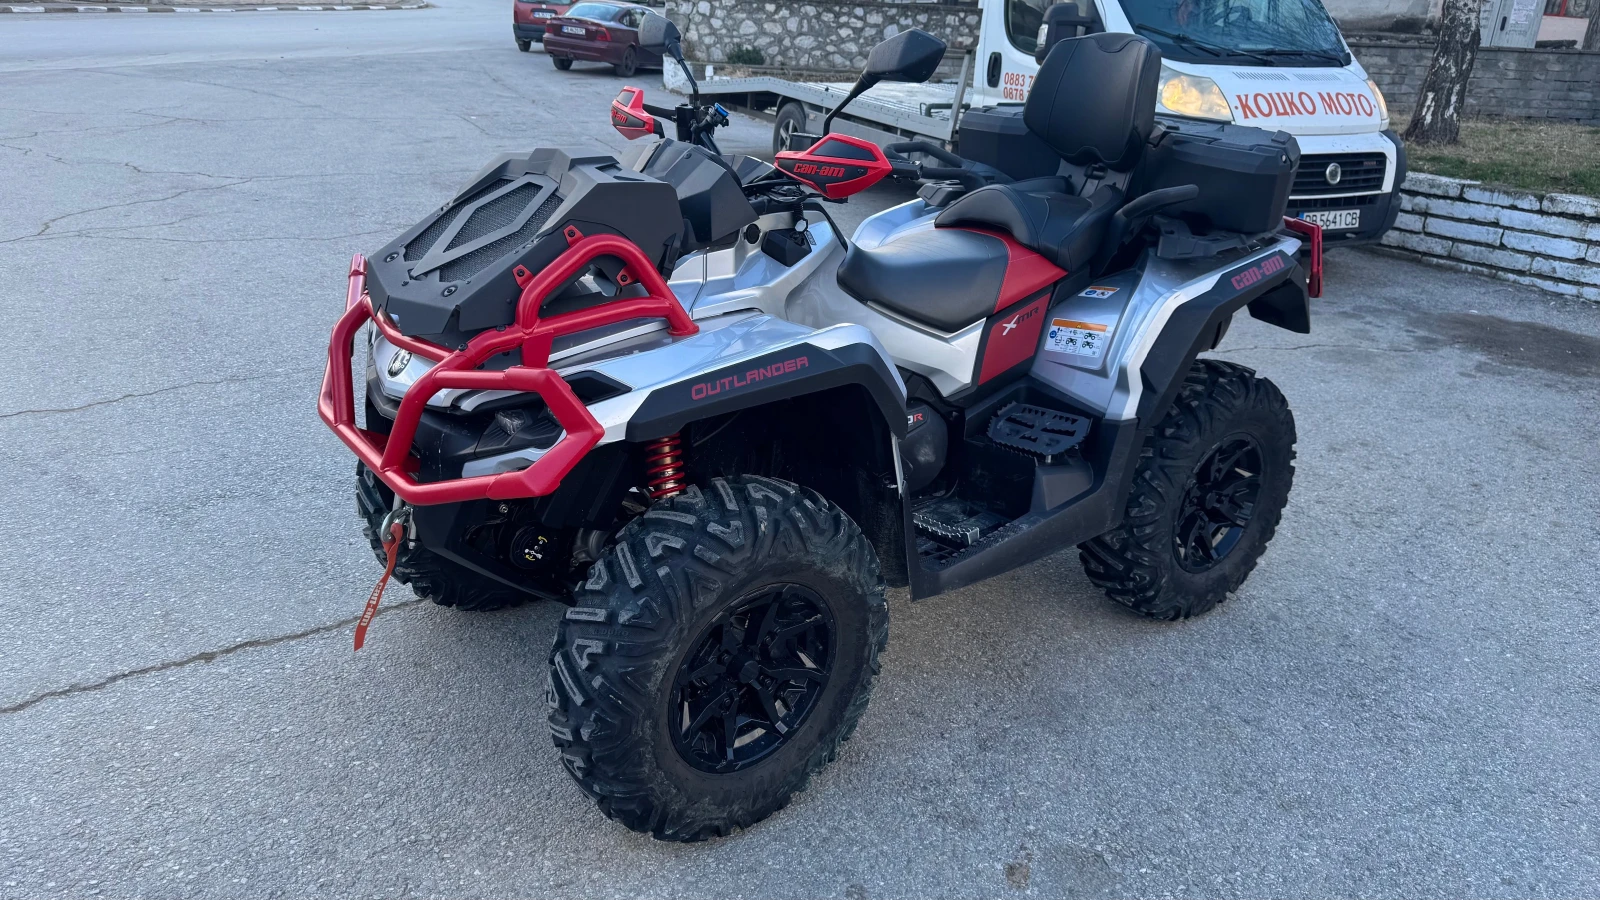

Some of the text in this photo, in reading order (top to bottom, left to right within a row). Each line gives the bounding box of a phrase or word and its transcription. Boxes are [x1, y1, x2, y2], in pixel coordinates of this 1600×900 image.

[1004, 72, 1026, 87] 0883
[1003, 87, 1025, 101] 0878
[1235, 91, 1374, 119] КОЦКО МОТО
[793, 163, 846, 178] can-am
[1231, 255, 1285, 290] can-am
[691, 356, 809, 400] OUTLANDER
